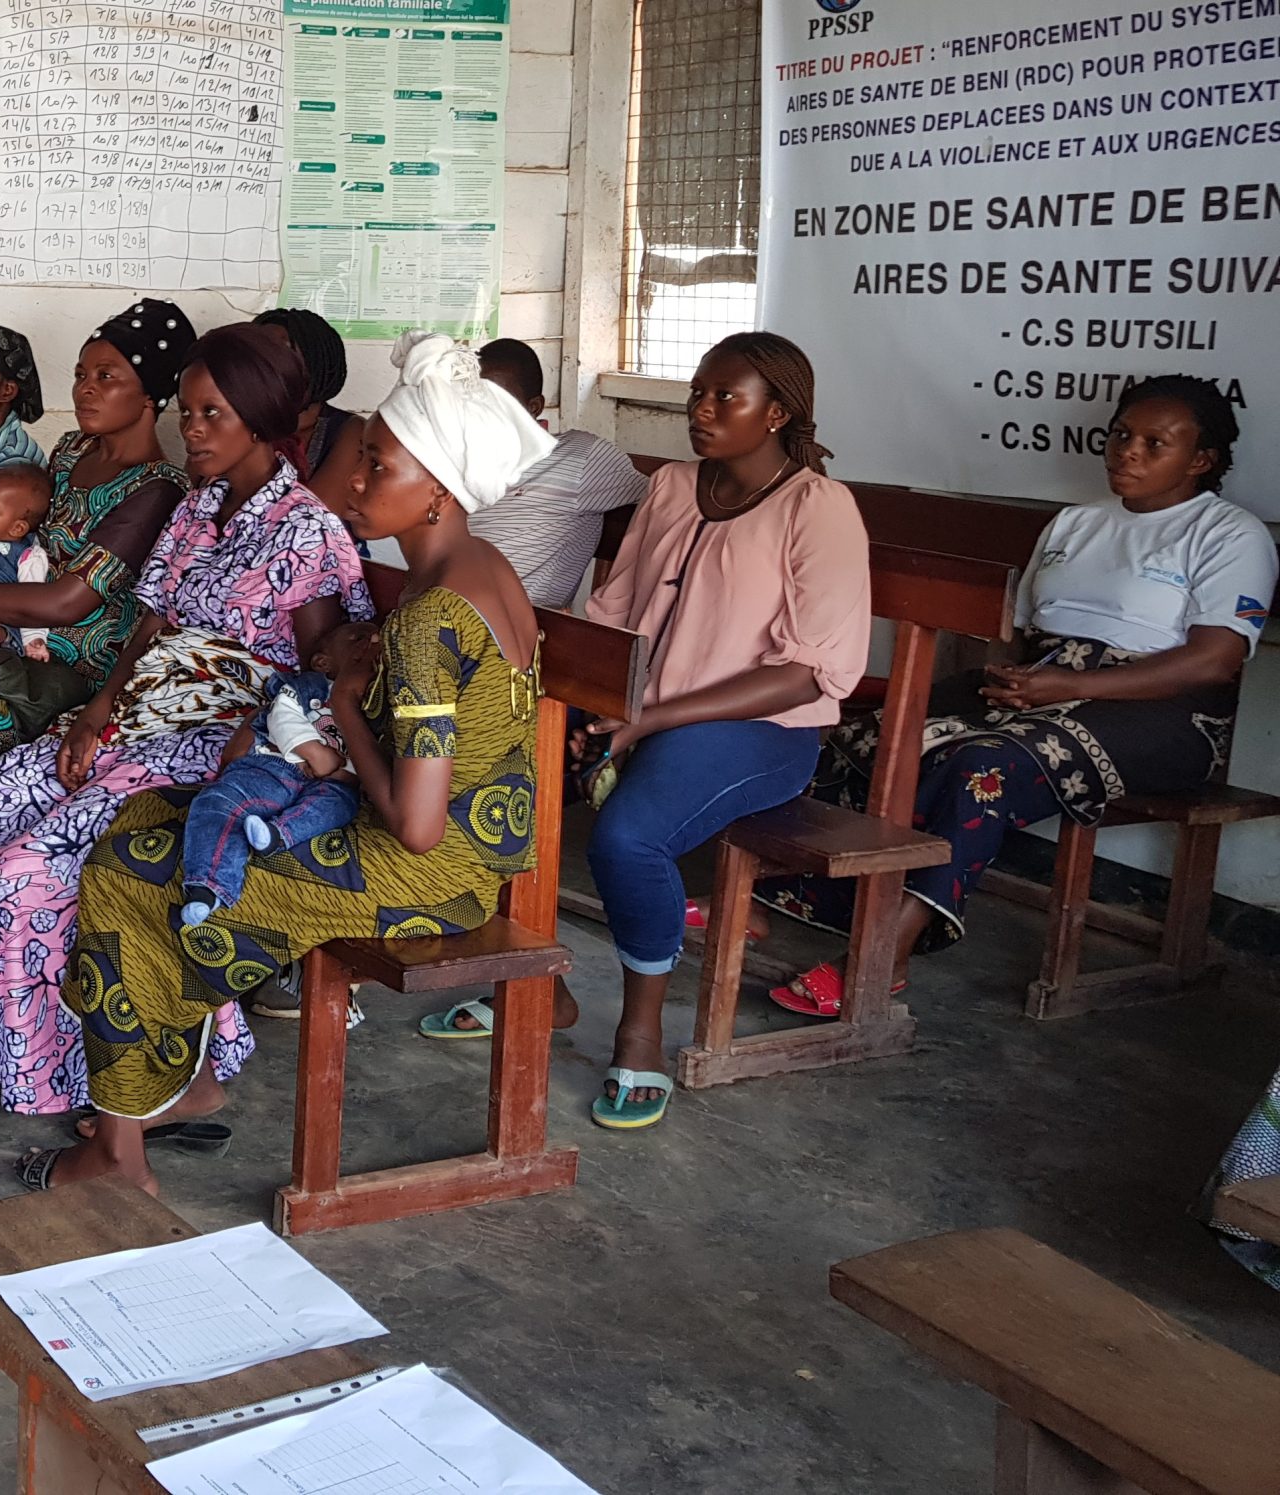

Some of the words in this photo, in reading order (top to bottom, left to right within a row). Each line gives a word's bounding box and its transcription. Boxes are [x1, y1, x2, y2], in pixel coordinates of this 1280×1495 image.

[776, 60, 816, 81] TITRE
[822, 55, 844, 75] DU
[850, 45, 924, 71] PROJET
[1131, 11, 1162, 33] DU
[1172, 0, 1280, 28] SYSTEM
[808, 11, 874, 40] PPSSP
[786, 91, 827, 113] AIRES
[833, 88, 854, 107] DE
[860, 80, 924, 103] SANTE
[931, 76, 955, 96] DE
[963, 69, 1008, 93] BENI
[1015, 62, 1073, 91] (RDC)
[1082, 53, 1144, 79] POUR
[1154, 37, 1280, 71] PROTEGE
[780, 127, 807, 146] DES
[812, 116, 915, 143] PERSONNES
[922, 103, 1045, 132] DEPLACEES
[1053, 96, 1113, 121] DANS
[1121, 92, 1151, 114] UN
[851, 154, 884, 173] DUE
[890, 151, 902, 169] A
[908, 148, 932, 168] LA
[1059, 138, 1085, 158] ET
[1091, 133, 1139, 156] AUX
[1147, 120, 1280, 152] URGENCES
[794, 207, 826, 237] EN
[834, 202, 915, 235] ZONE
[929, 199, 973, 232] DE
[986, 191, 1115, 230] SANTE
[1129, 188, 1185, 224] DE
[853, 263, 947, 294] AIRES
[962, 262, 1007, 293] DE
[1021, 259, 1152, 293] SANTE
[1022, 319, 1074, 348] C.S
[1087, 319, 1216, 350] BUTSILI
[994, 370, 1044, 399] C.S
[1001, 422, 1050, 451] C.S
